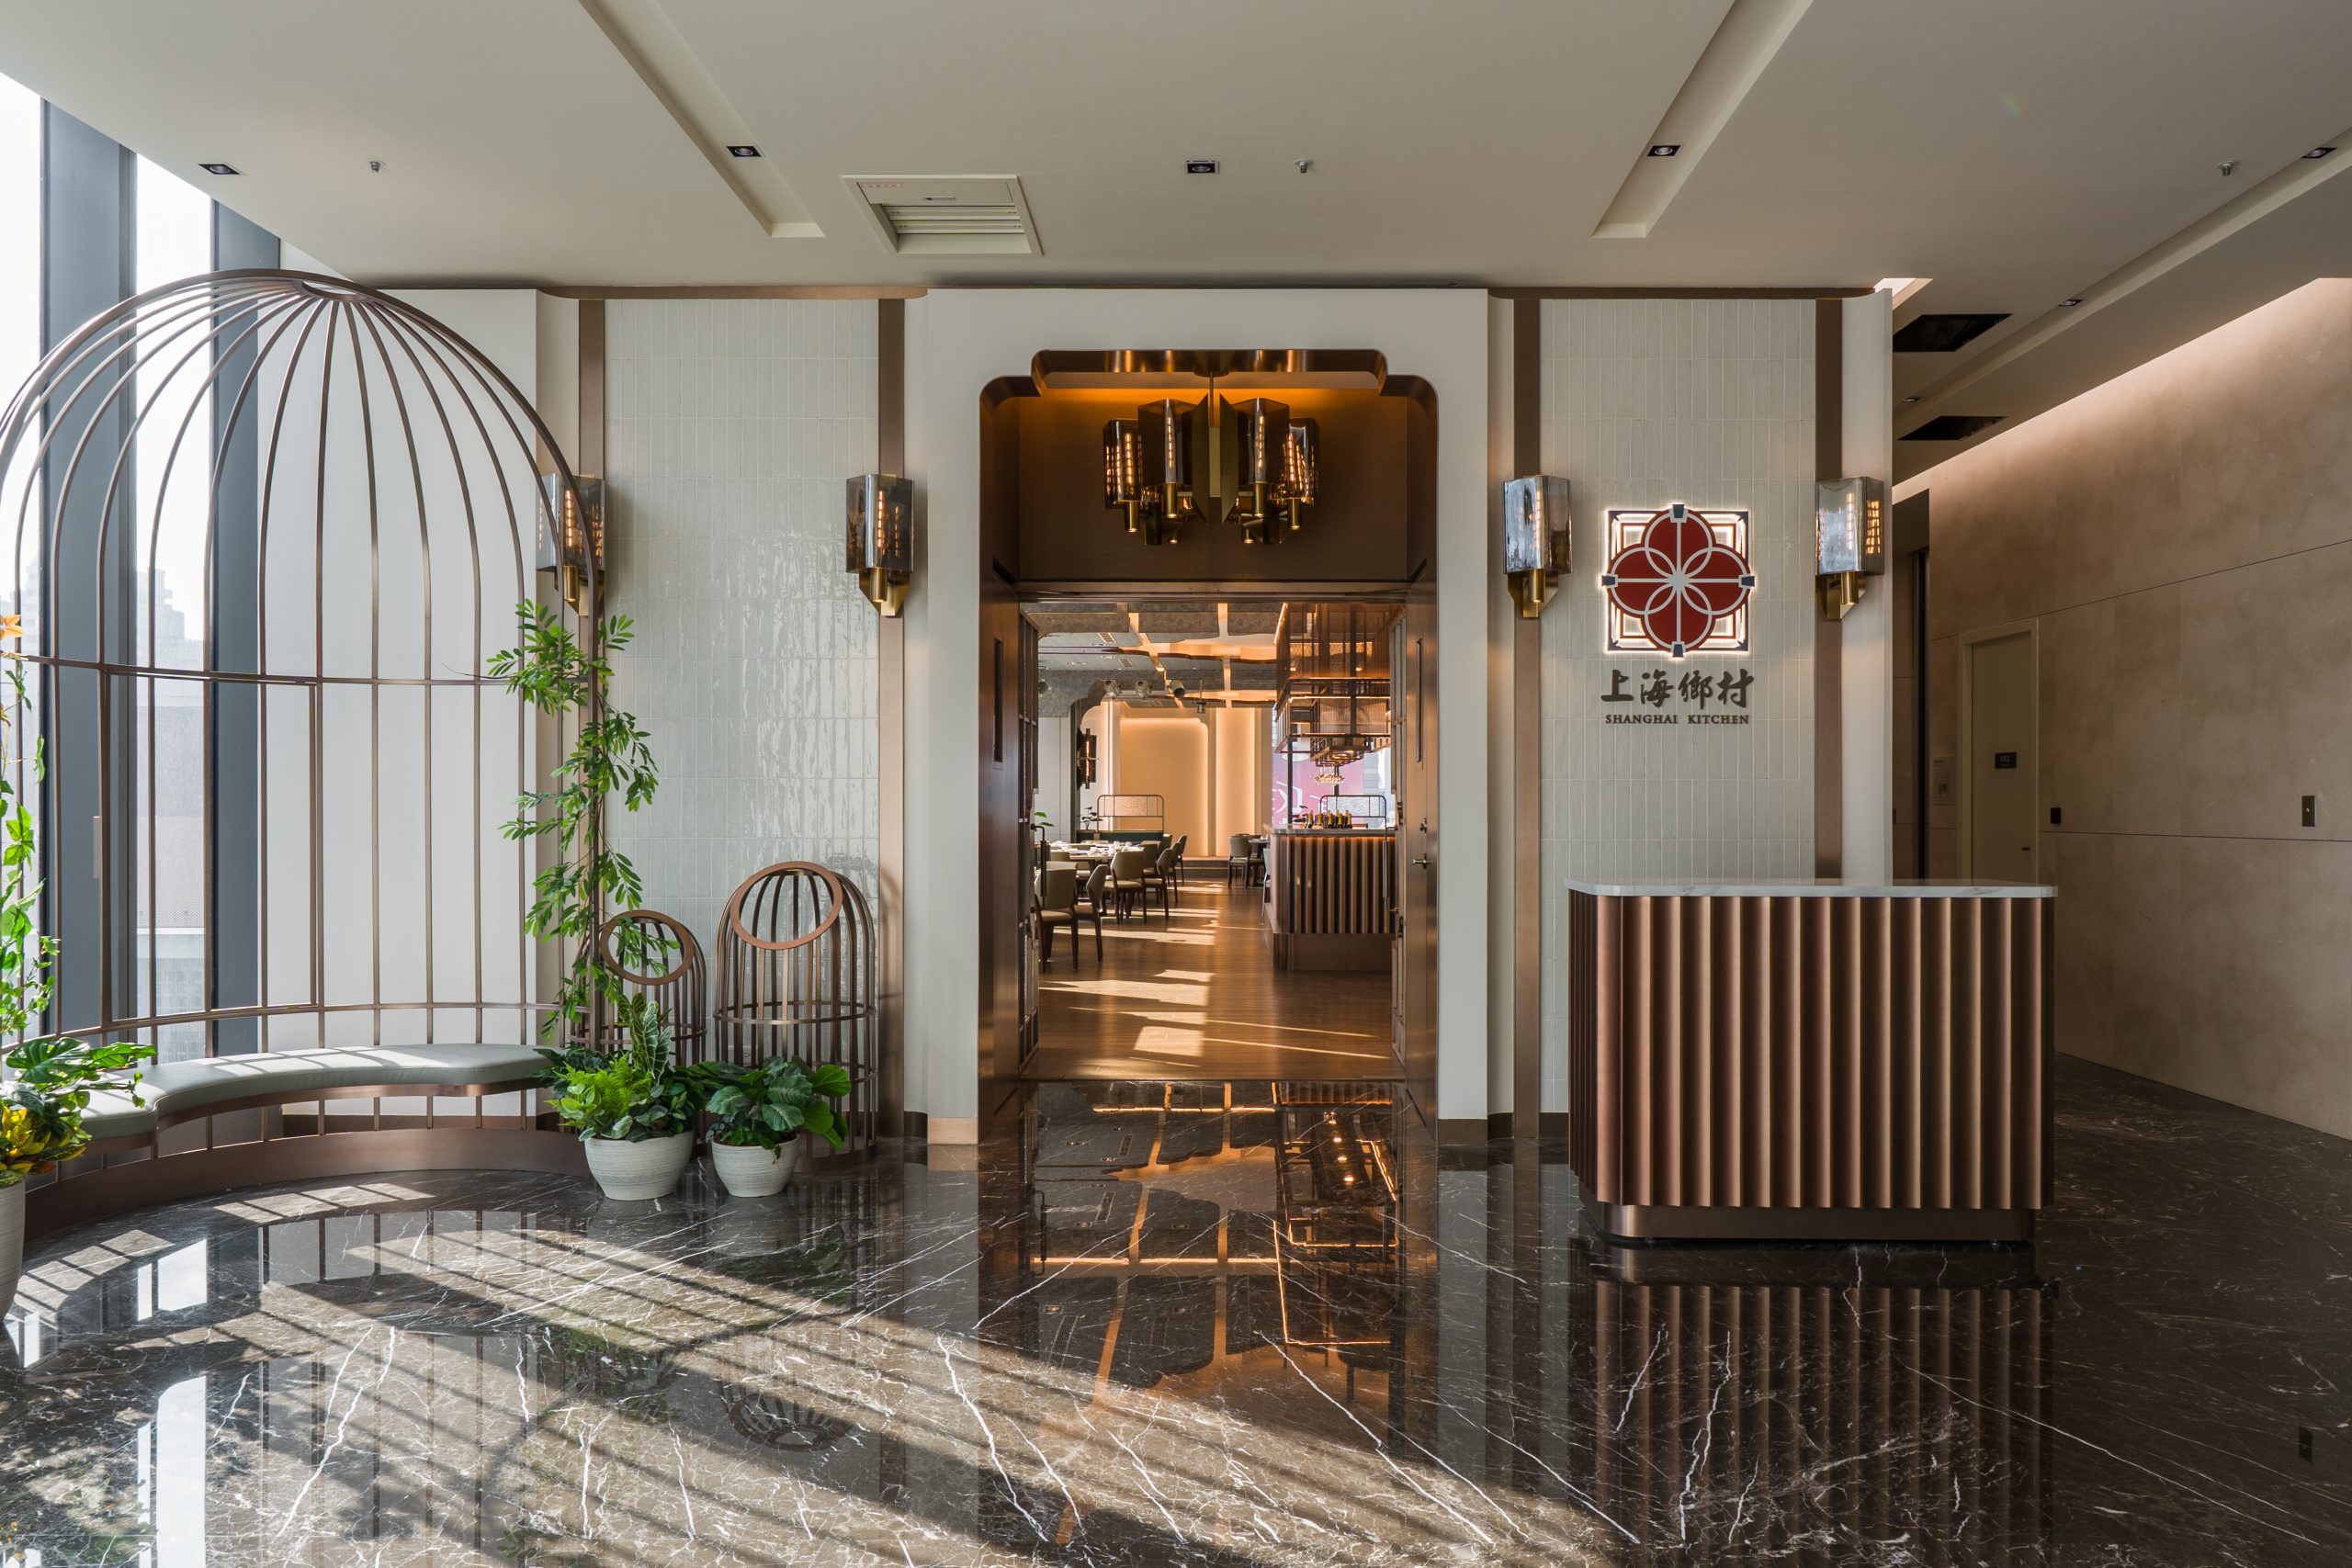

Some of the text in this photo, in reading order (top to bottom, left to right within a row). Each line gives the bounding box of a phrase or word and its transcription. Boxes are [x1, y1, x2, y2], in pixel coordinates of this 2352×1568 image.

[1600, 669, 1754, 710] 上海鄉村
[1605, 715, 1749, 725] SHANGHAI KITCHEN
